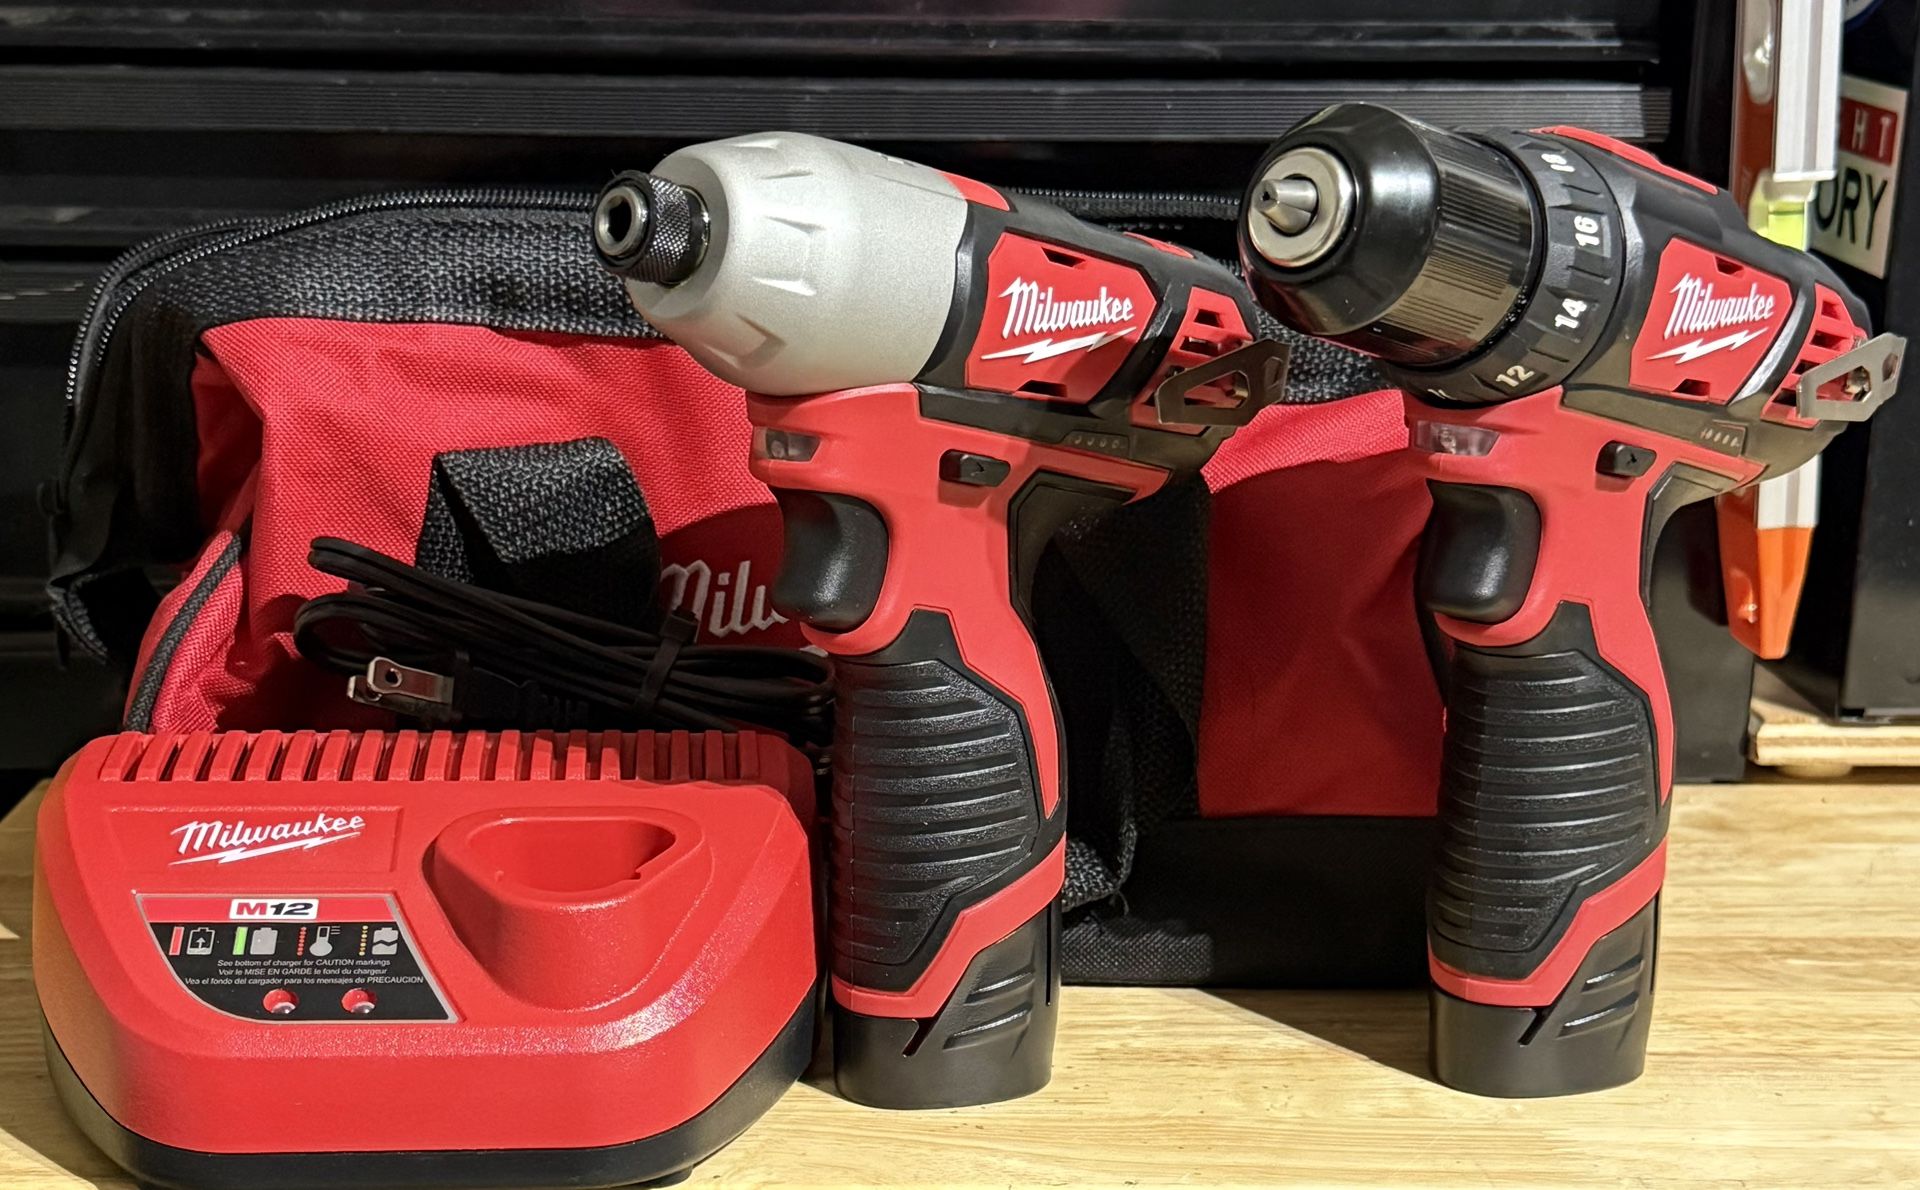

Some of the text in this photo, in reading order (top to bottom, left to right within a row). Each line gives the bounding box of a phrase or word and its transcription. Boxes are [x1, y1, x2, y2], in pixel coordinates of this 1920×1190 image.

[1573, 215, 1600, 247] 16
[998, 276, 1136, 340] Milwaukee
[1555, 298, 1588, 329] 14
[1664, 272, 1775, 340] Milwaukee
[1496, 365, 1537, 388] 12
[170, 812, 366, 855] Milwaukee
[235, 901, 315, 917] M12
[217, 959, 233, 967] See
[234, 959, 262, 967] bottom
[263, 959, 272, 967] of
[272, 959, 302, 968] charger
[355, 959, 391, 967] markings
[218, 968, 234, 976] Voir
[244, 968, 266, 976] MISE
[353, 968, 388, 976] chargeur
[248, 978, 282, 986] cargador
[283, 978, 302, 986] para
[316, 977, 353, 985] mensajes
[366, 976, 424, 984] PRECAUCION
